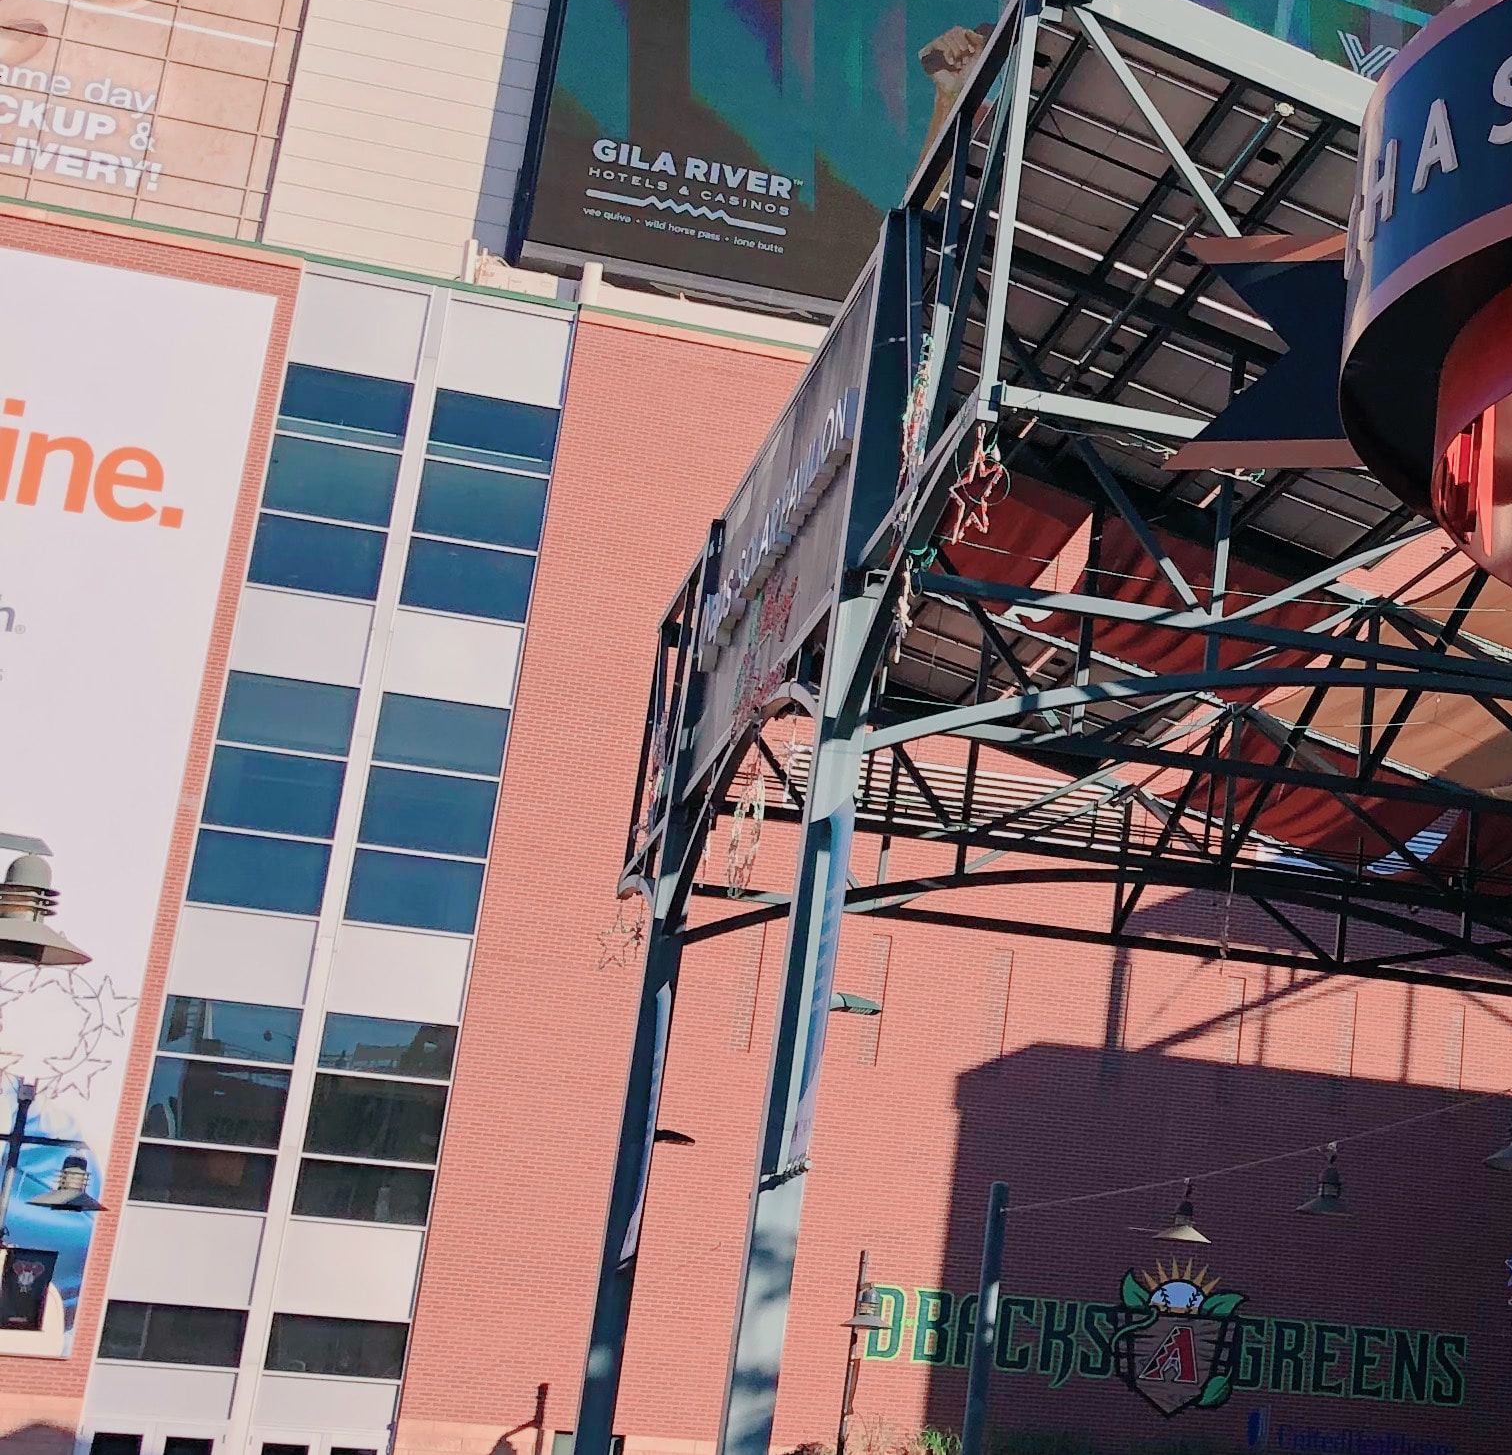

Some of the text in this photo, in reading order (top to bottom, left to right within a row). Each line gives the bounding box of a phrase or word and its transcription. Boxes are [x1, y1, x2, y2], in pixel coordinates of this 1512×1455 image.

[84, 78, 156, 119] day
[129, 121, 156, 153] &
[592, 138, 678, 177] GILA
[588, 166, 791, 217] HOTELS & CASINOS
[644, 218, 666, 231] wild
[1231, 1315, 1469, 1407] GREENS
